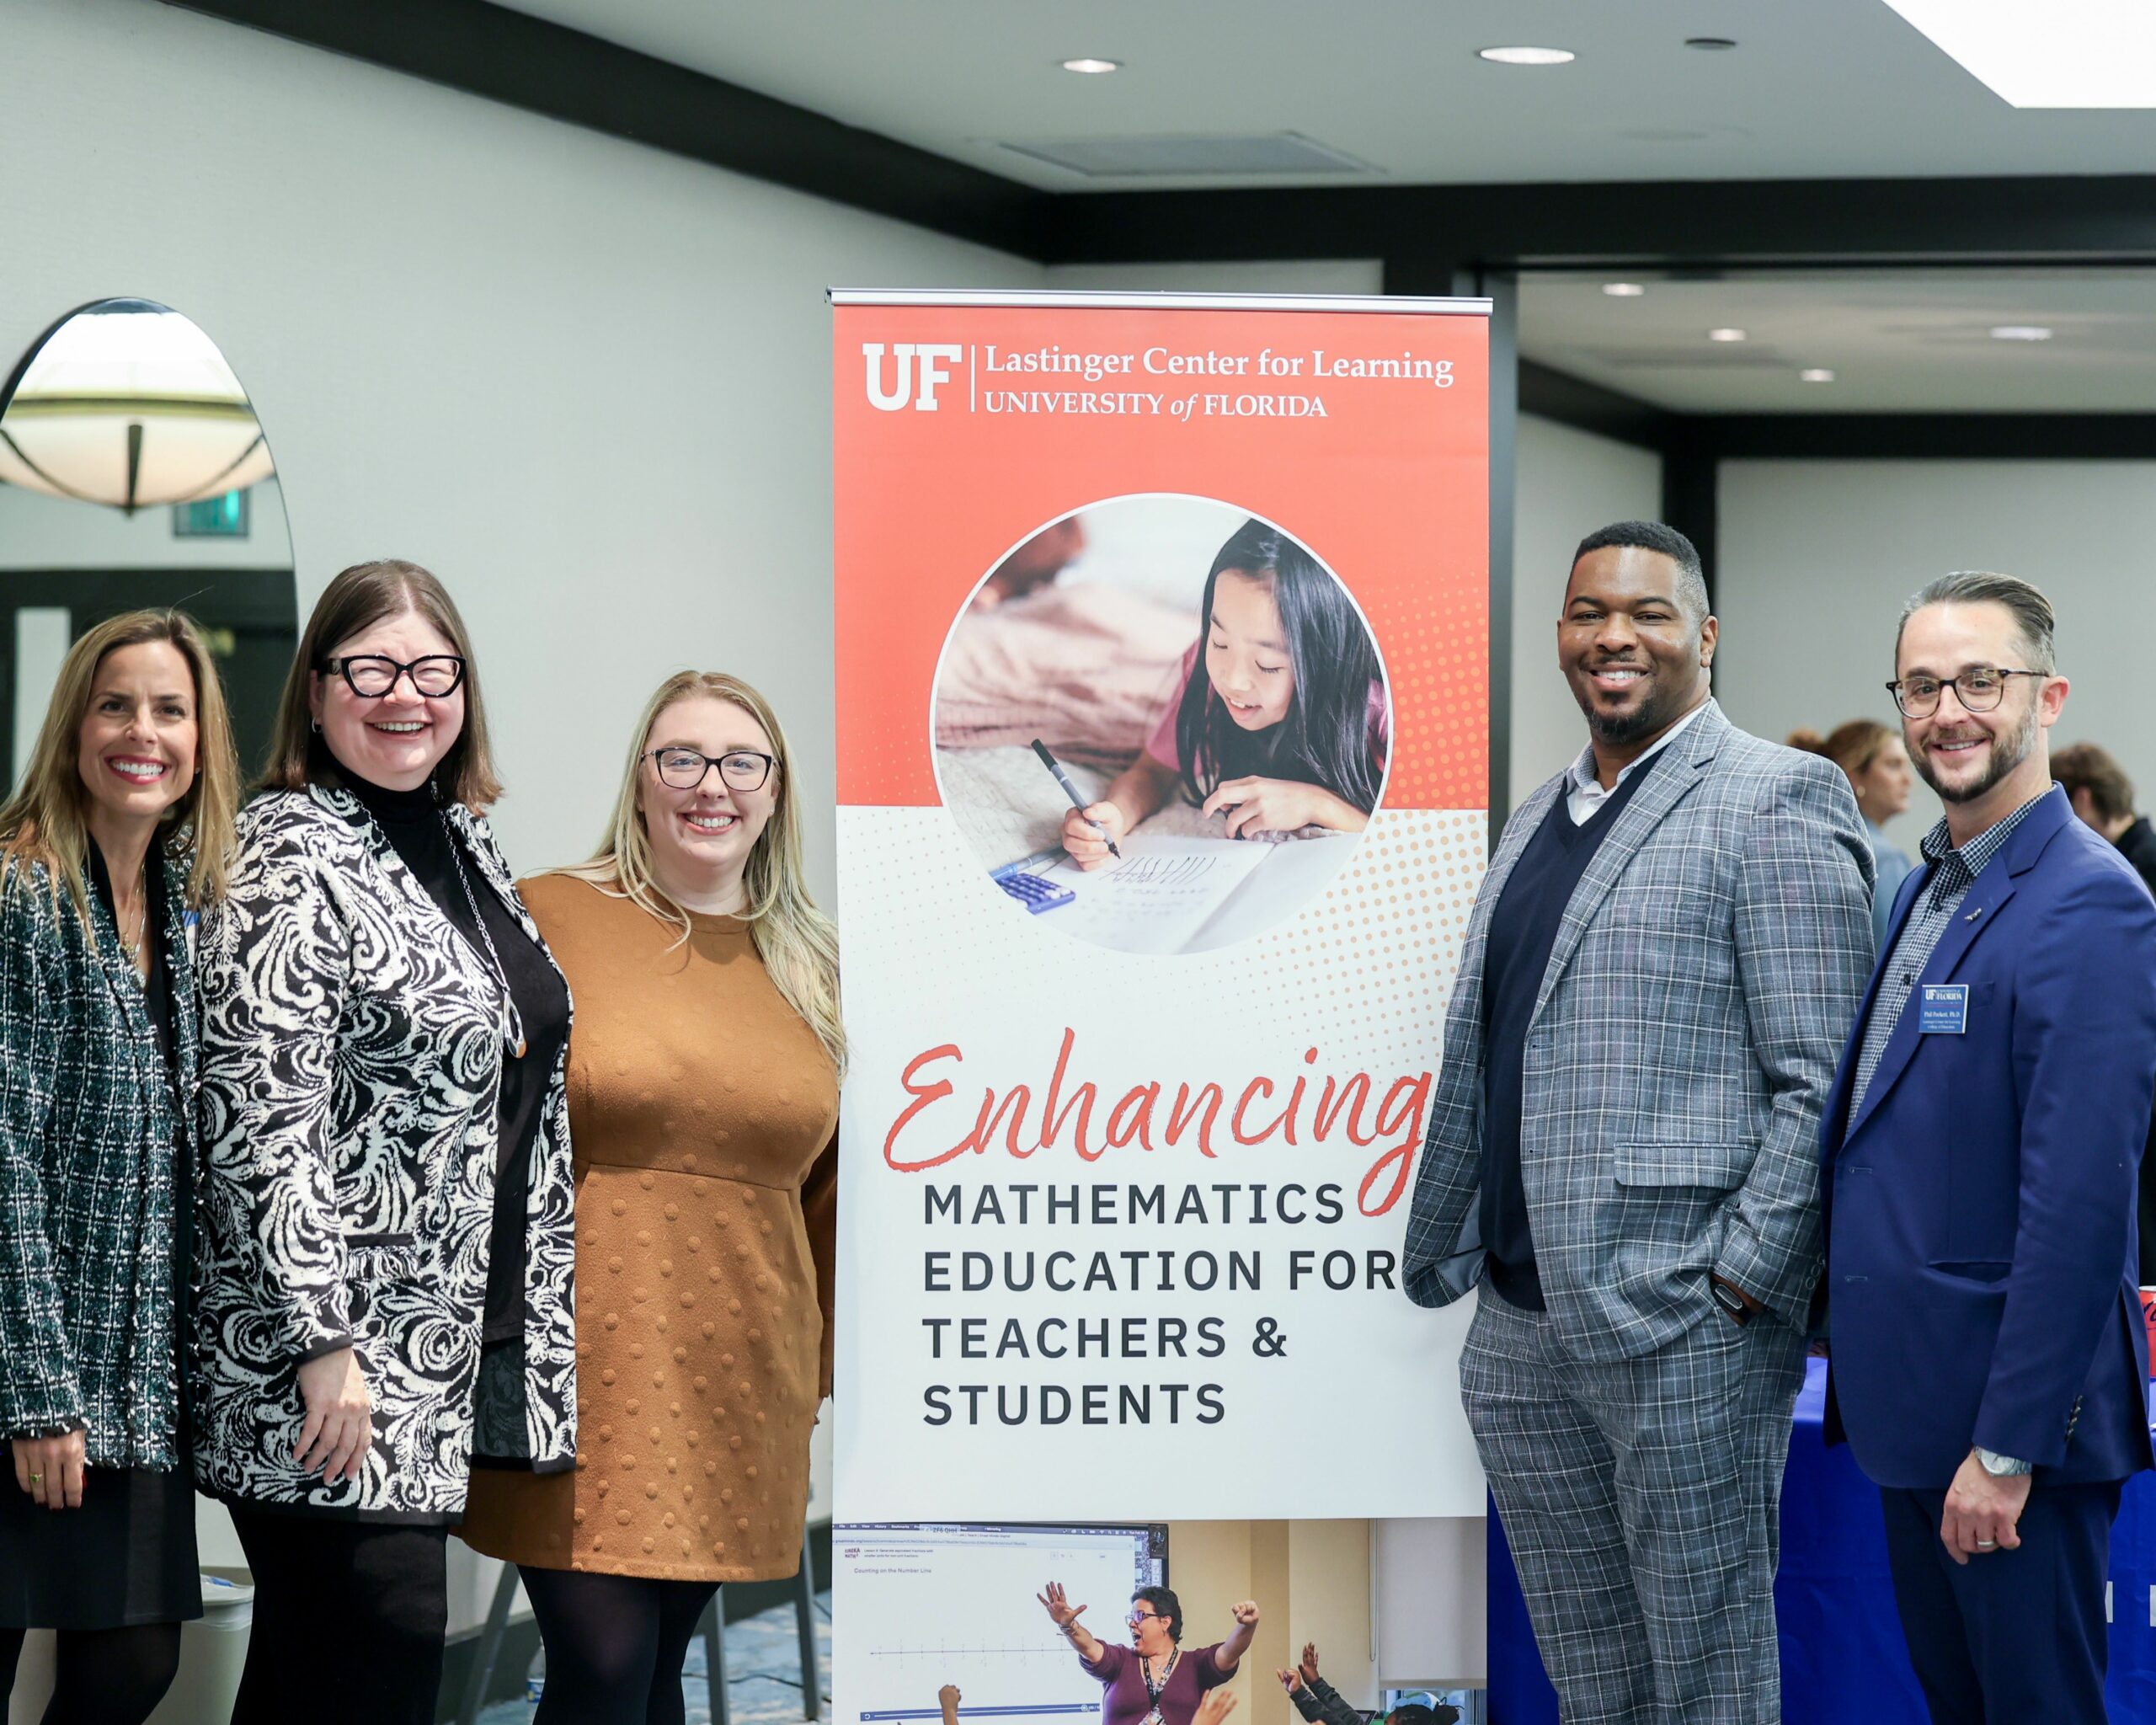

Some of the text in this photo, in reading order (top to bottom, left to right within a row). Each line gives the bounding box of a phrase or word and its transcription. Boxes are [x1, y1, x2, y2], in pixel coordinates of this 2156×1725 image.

[862, 343, 963, 412] UF
[985, 345, 1454, 388] Lastinger Center for Learning
[984, 391, 1328, 422] UNIVERSITY of FLORIDA
[1925, 989, 1936, 1001] UF
[883, 1027, 1433, 1217] Enhancing
[924, 1183, 1344, 1226] MATHEMATICS
[925, 1249, 1396, 1292] EDUCATION FOR
[922, 1316, 1287, 1359] TEACHERS &
[923, 1383, 1225, 1426] STUDENTS
